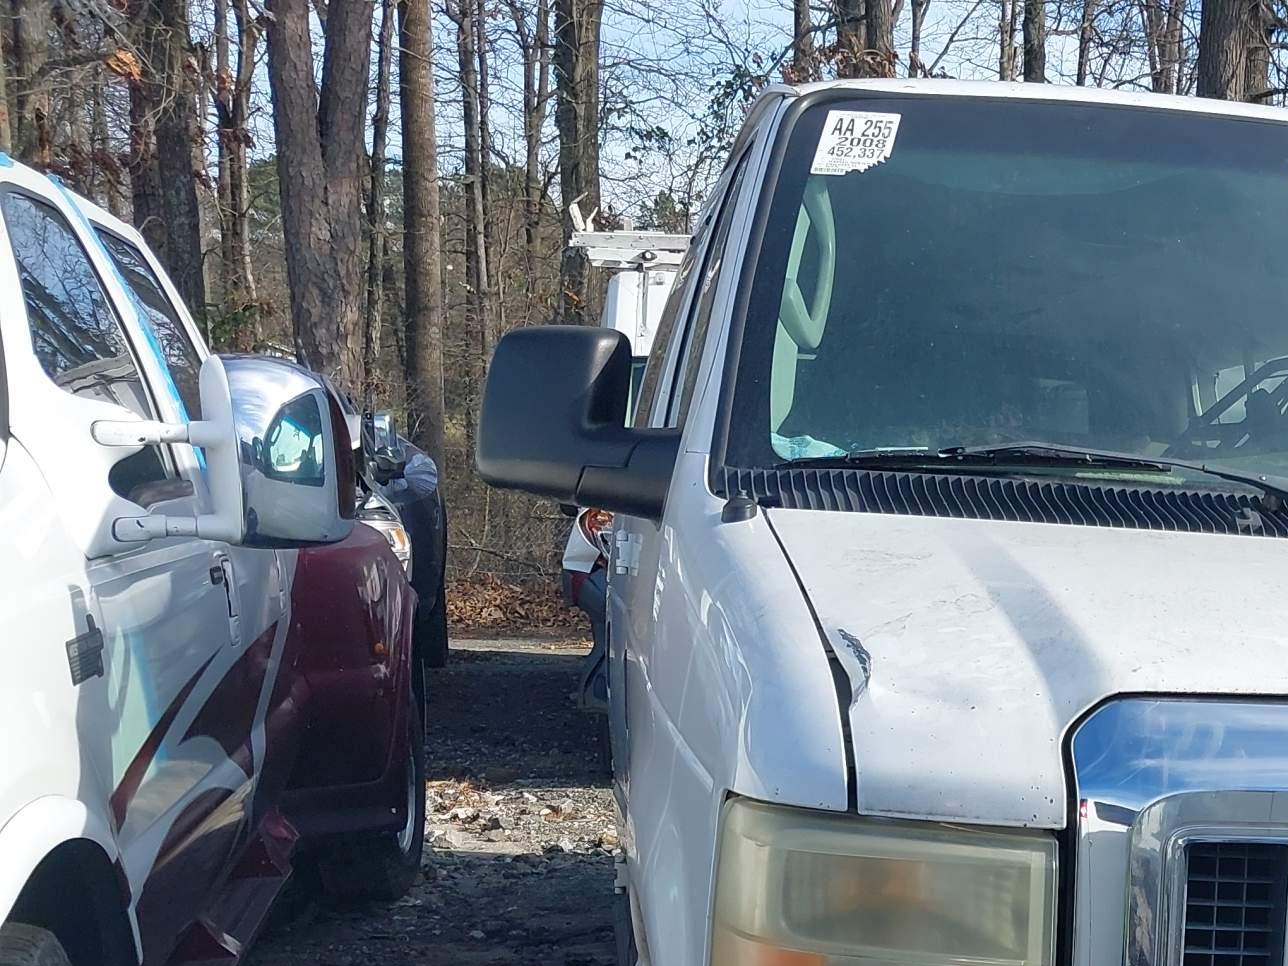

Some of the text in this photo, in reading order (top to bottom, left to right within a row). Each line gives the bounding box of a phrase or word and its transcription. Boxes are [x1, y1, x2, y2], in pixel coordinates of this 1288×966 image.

[831, 118, 894, 139] AA 255
[836, 137, 887, 149] 2008
[827, 146, 885, 159] 452,337
